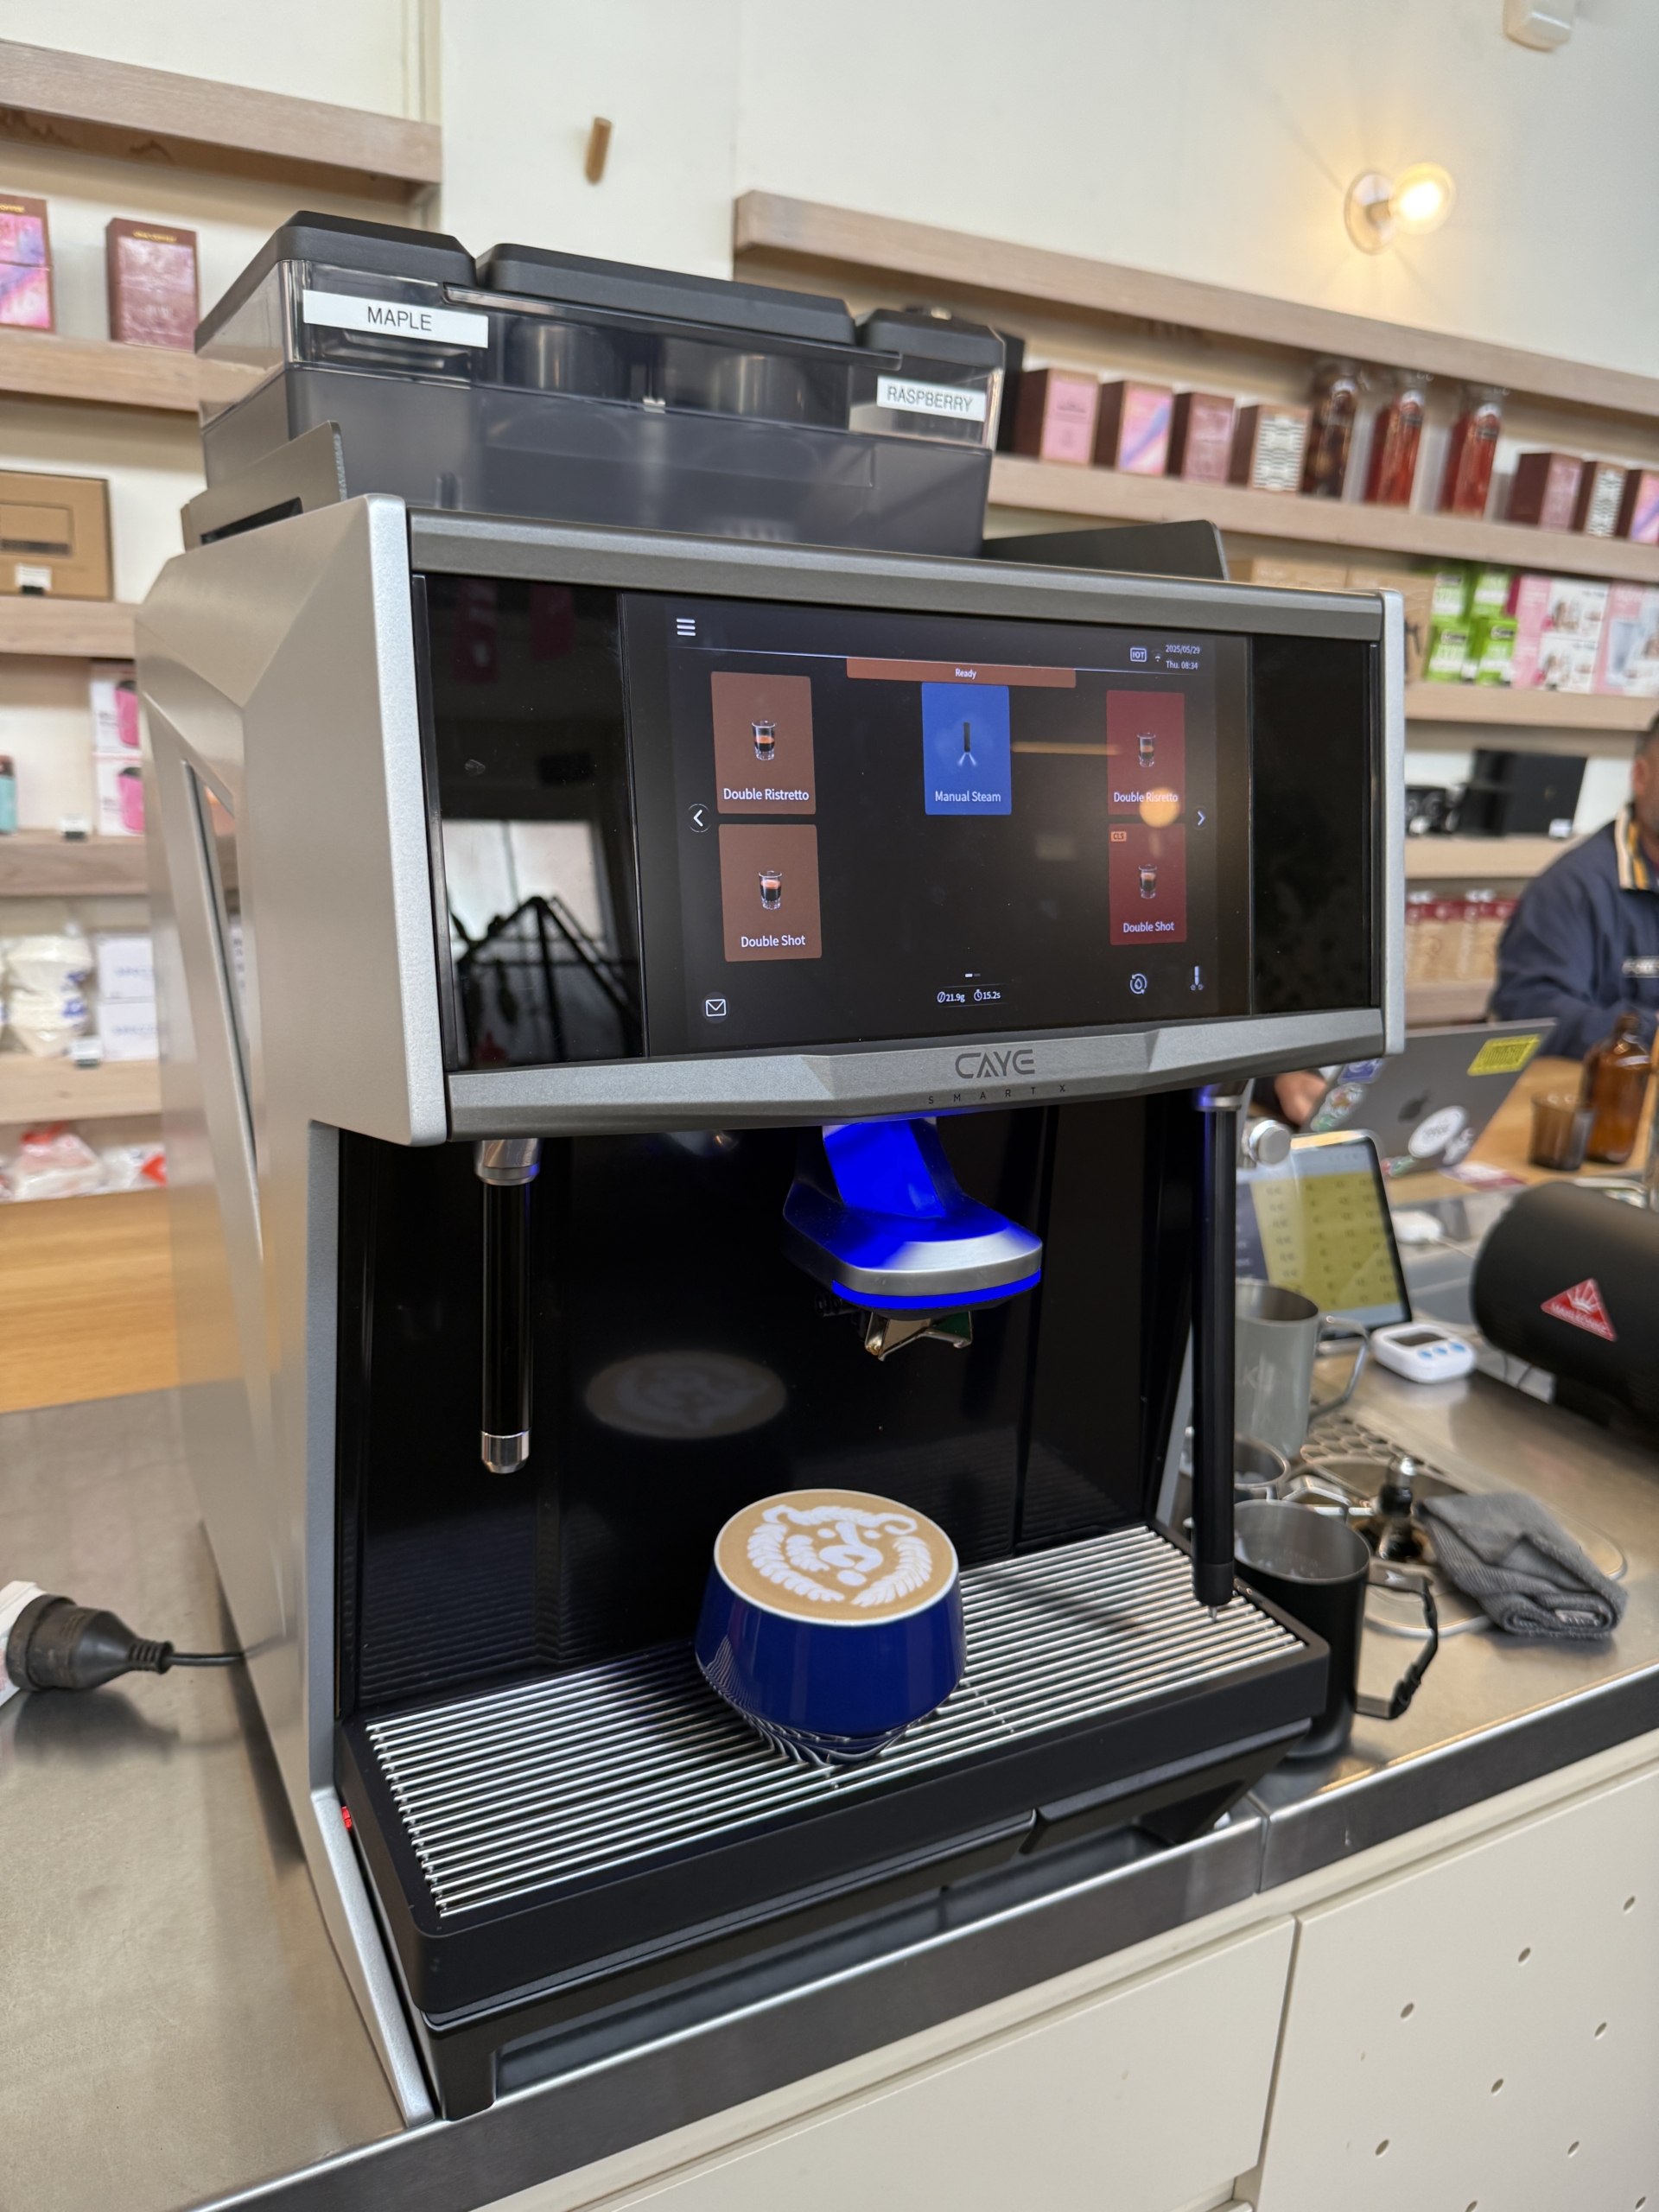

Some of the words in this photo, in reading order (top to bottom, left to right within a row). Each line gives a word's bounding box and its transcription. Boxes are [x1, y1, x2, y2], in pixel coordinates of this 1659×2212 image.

[367, 305, 432, 332] MAPLE
[887, 385, 973, 412] RASPBERRY
[1132, 651, 1145, 659] IOT
[1165, 645, 1201, 655] 2025/05/29
[1166, 660, 1180, 669] Thu.
[1180, 661, 1198, 670] 08:34
[955, 668, 977, 680] Ready
[723, 787, 763, 800] Double
[765, 788, 810, 801] Ristretto
[935, 790, 969, 802] Manual
[971, 791, 1001, 802] Steam
[1113, 791, 1145, 803] Double
[1146, 791, 1179, 803] Risretto
[1112, 832, 1125, 841] CLS
[1122, 920, 1154, 933] Double
[1154, 920, 1174, 931] Shot
[741, 935, 779, 948] Double
[781, 934, 806, 946] Shot
[945, 994, 966, 1003] 21.9g
[982, 990, 1001, 1001] 15.2s
[955, 1049, 1036, 1079] CAYE
